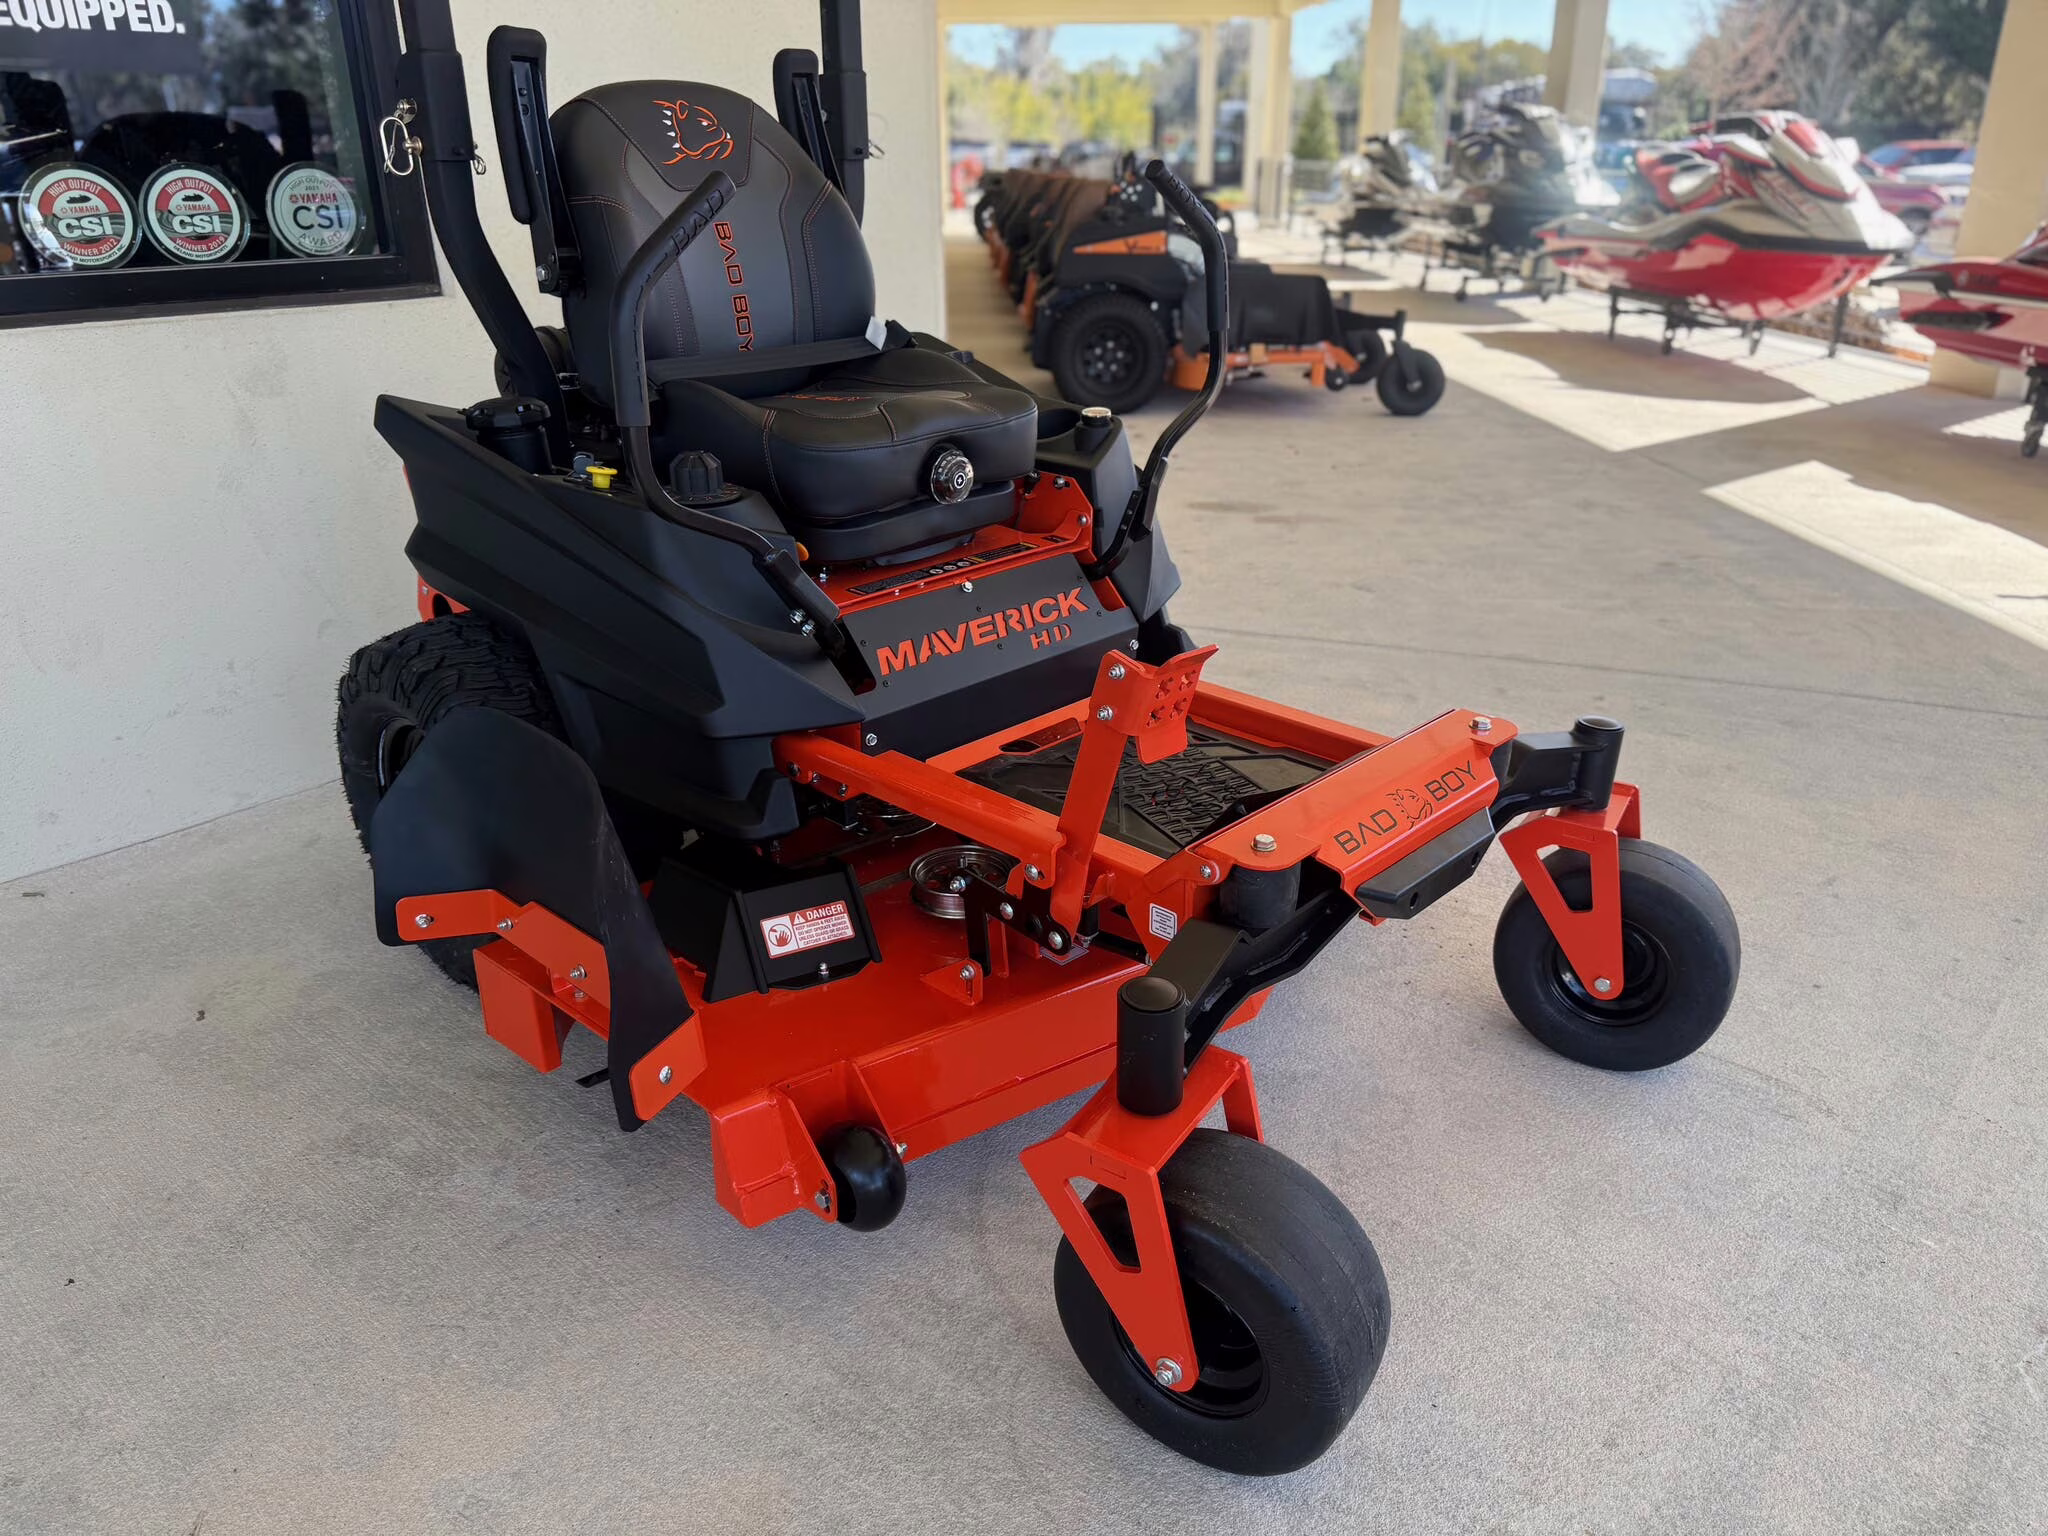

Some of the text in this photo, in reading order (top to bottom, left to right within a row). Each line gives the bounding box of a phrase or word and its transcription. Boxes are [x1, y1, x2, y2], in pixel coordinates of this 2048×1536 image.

[47, 179, 102, 198] HIGH OUTPUT
[165, 178, 214, 195] HIGH OUTPUT
[301, 192, 338, 204] YAMAHA
[69, 204, 100, 214] YAMAHA
[293, 204, 344, 230] CSI
[58, 216, 113, 238] CSI
[172, 215, 222, 234] CSI
[63, 239, 118, 256] WINNER 2012
[175, 238, 209, 252] WINNER
[300, 230, 342, 246] AWARD
[713, 221, 754, 351] BAD BOY
[876, 586, 1088, 676] MAVERICK
[1030, 623, 1072, 650] HD
[1333, 760, 1476, 855] BAD BOY
[806, 903, 844, 920] DANGER
